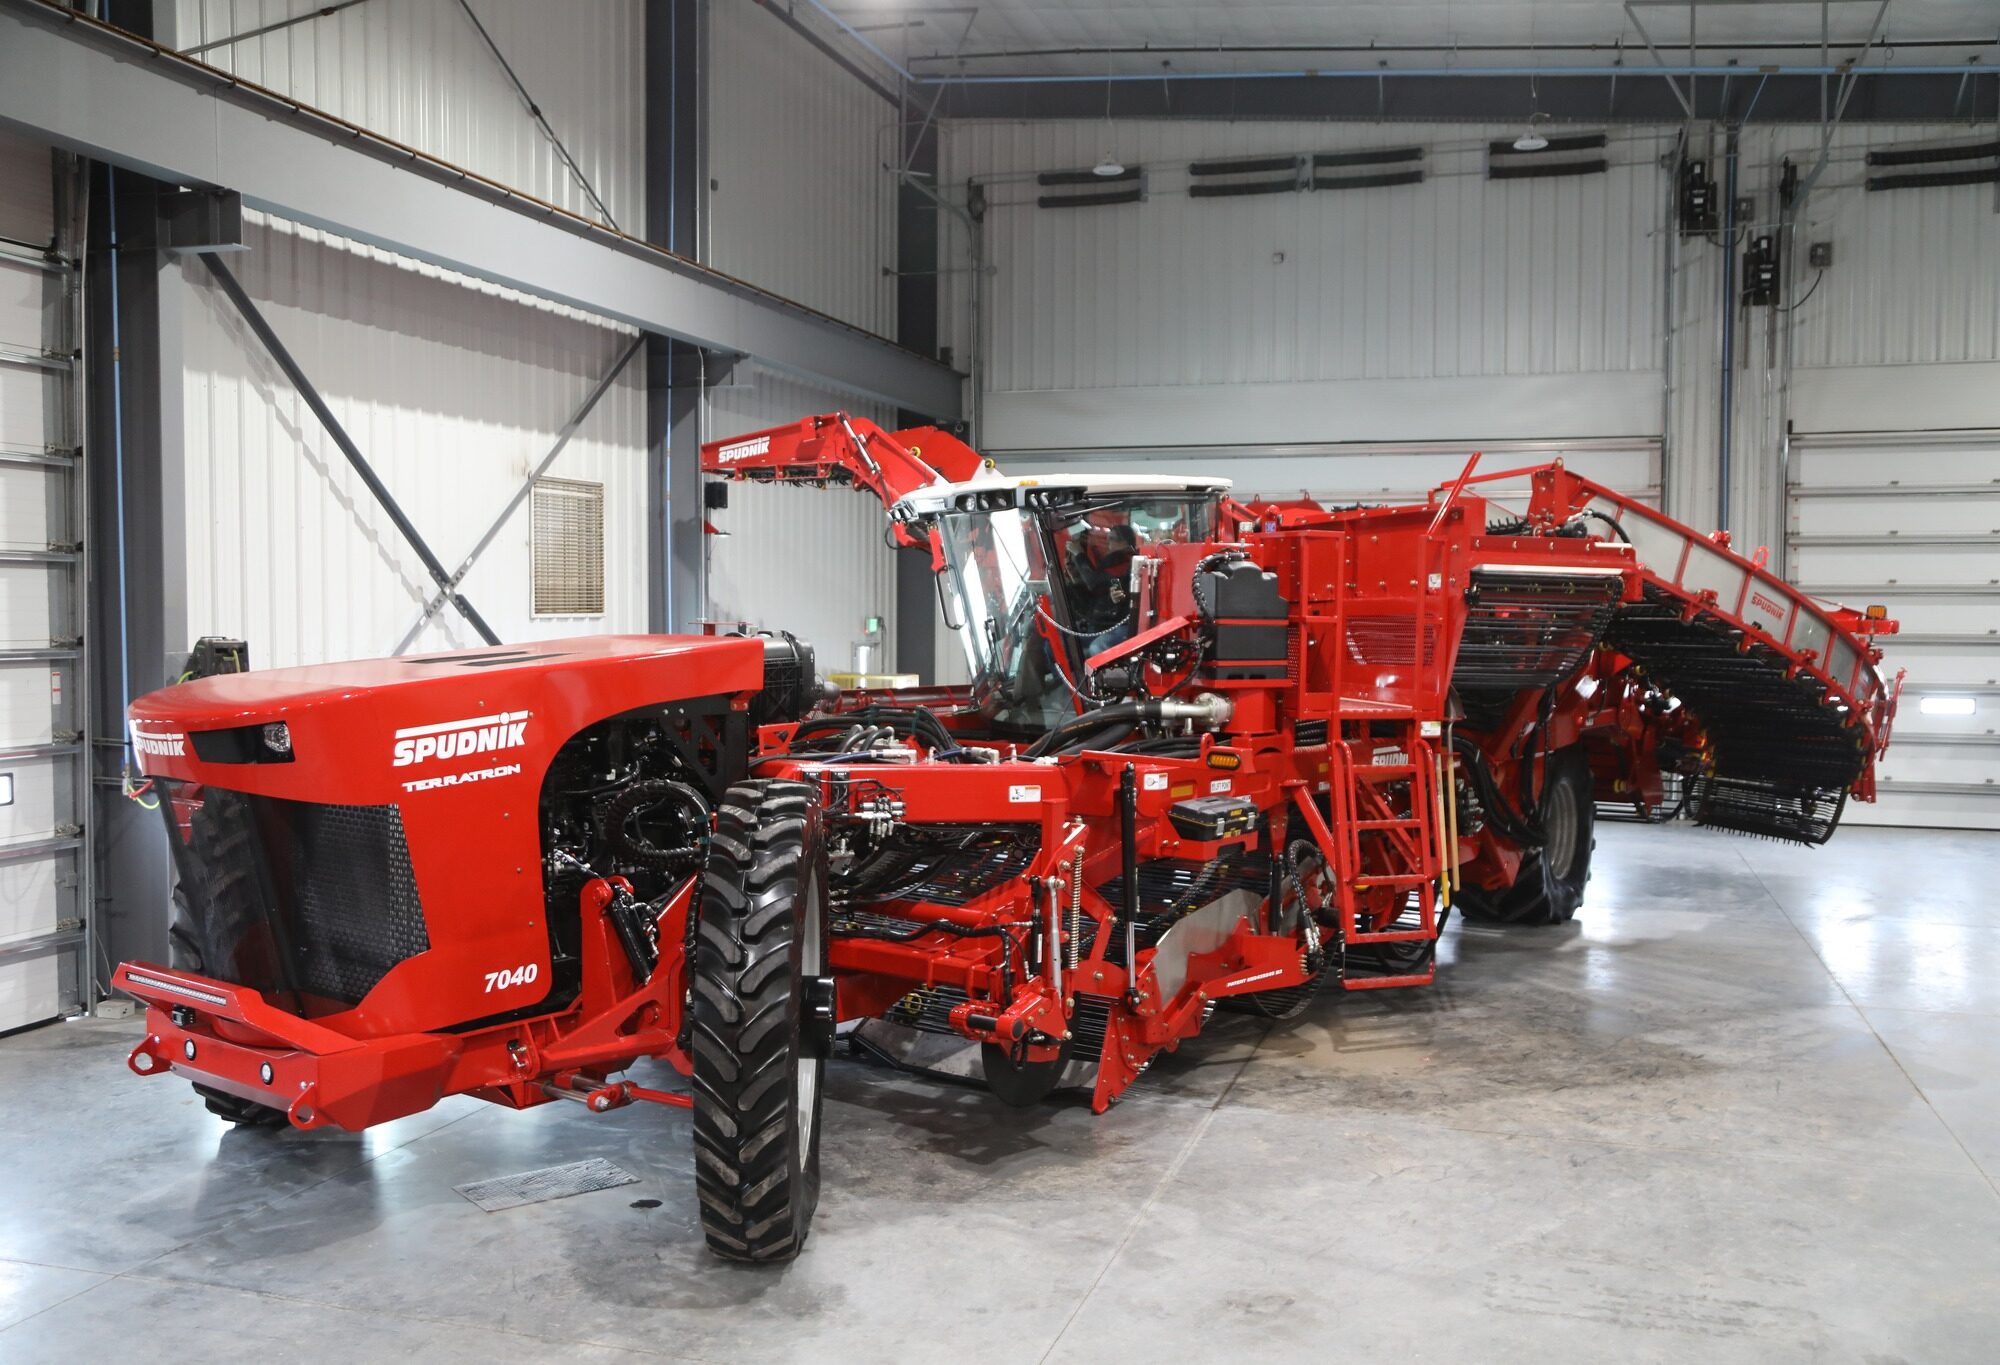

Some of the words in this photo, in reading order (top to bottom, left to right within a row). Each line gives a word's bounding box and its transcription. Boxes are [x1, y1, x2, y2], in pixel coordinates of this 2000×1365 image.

[719, 437, 770, 464] SPUDNIK
[1752, 592, 1785, 620] SPUDNIK
[393, 711, 528, 767] SPUDNIK
[1372, 746, 1409, 766] SPUDN
[402, 763, 521, 793] TERRATRON
[485, 963, 538, 993] 7040
